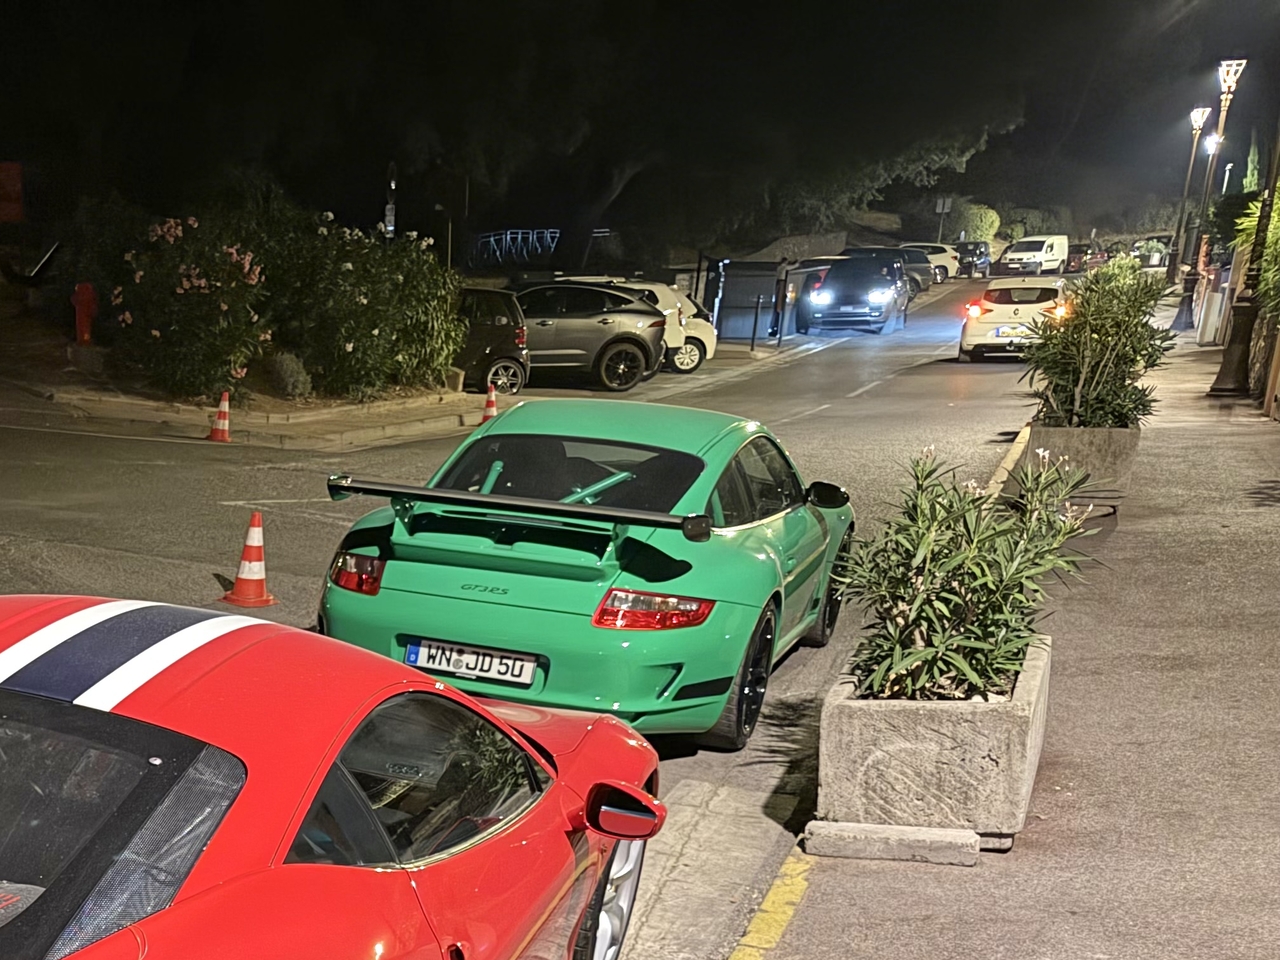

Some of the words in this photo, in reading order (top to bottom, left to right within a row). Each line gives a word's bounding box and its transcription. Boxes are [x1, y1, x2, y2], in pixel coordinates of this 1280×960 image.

[426, 644, 454, 668] WN
[465, 651, 494, 673] JD
[497, 656, 524, 678] 50
